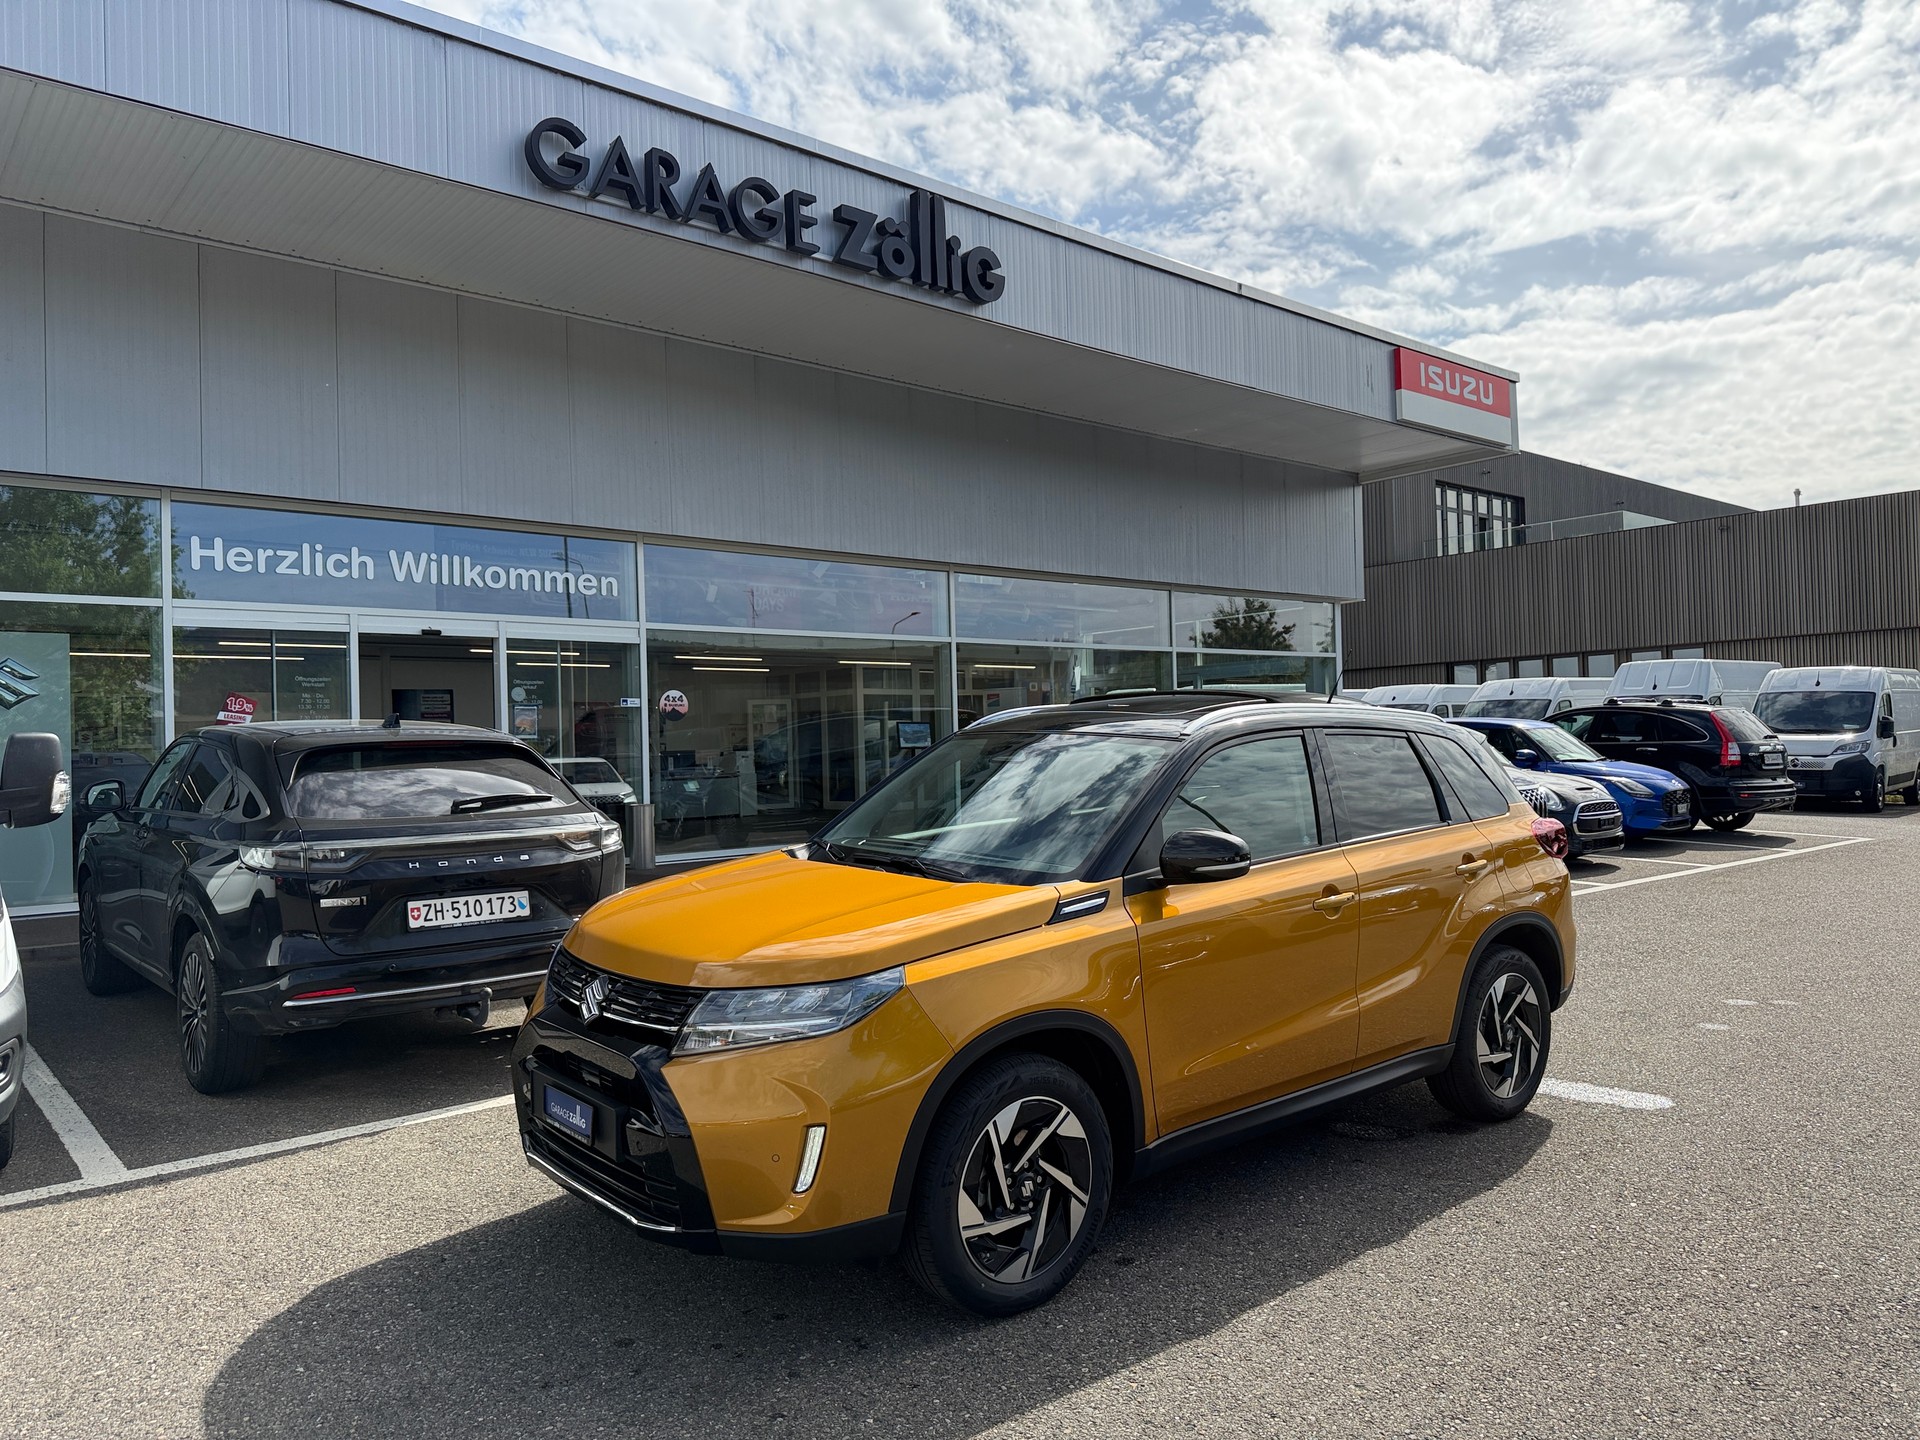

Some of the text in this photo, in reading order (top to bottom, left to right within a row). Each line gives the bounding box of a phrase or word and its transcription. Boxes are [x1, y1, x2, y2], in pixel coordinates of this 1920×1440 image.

[524, 116, 820, 256] GARAGE
[1419, 361, 1494, 406] ISUZU
[189, 535, 619, 597] Herzlich Willkommen
[224, 713, 247, 721] LEASING
[664, 694, 684, 703] 4x4
